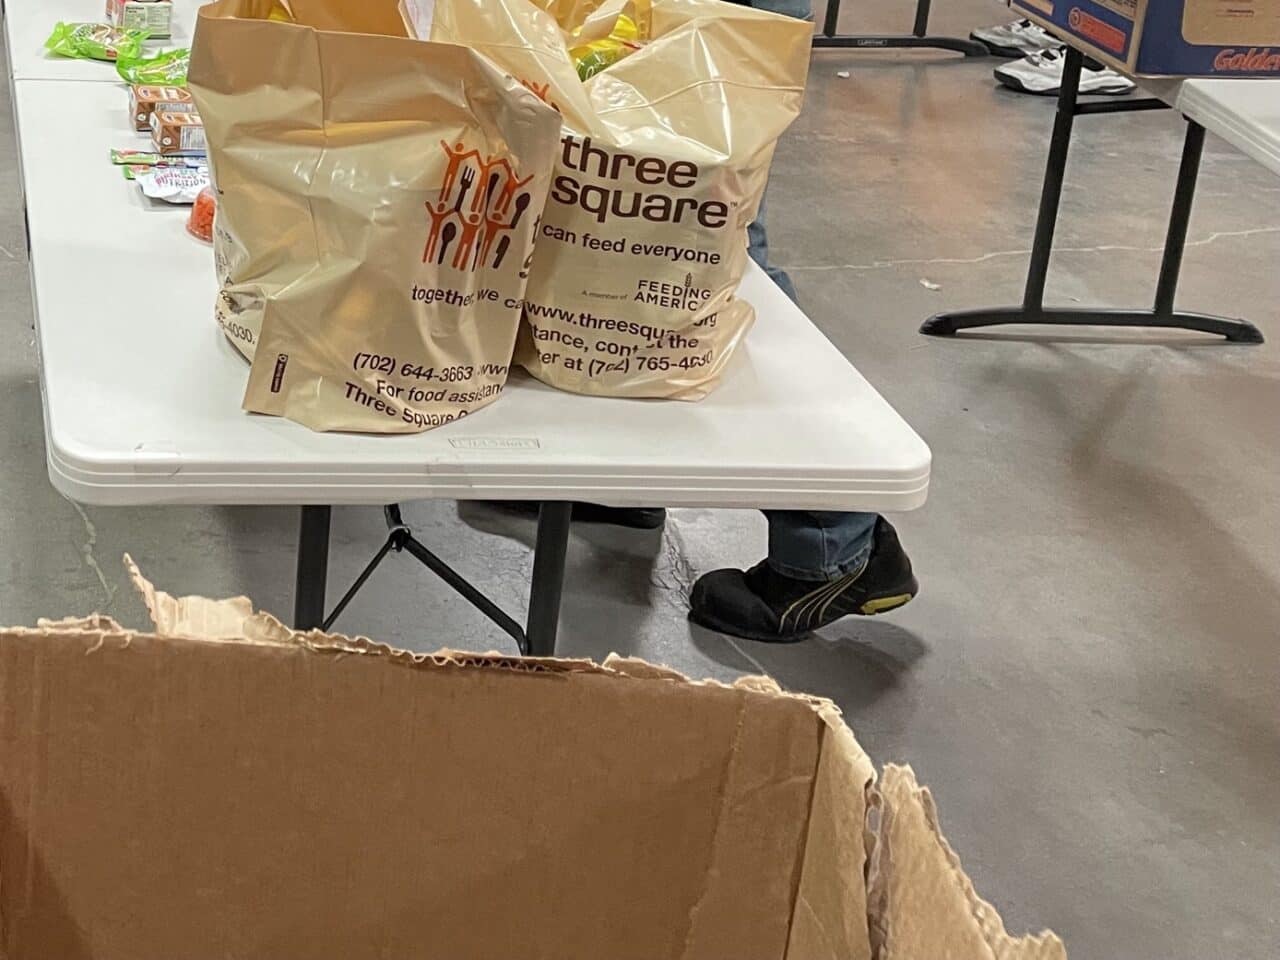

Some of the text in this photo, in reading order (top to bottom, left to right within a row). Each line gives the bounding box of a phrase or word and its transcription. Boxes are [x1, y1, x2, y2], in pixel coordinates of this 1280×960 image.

[561, 134, 699, 189] three
[551, 175, 729, 229] square
[543, 224, 721, 265] can feed everyone
[476, 289, 500, 301] we
[634, 291, 698, 312] AMERIC
[638, 279, 712, 301] FEEDING
[669, 334, 699, 349] the
[353, 351, 397, 376] (702)
[400, 362, 474, 382] 644-3663
[564, 357, 584, 371] at
[376, 379, 407, 398] For
[407, 387, 448, 403] food
[345, 381, 398, 417] Three
[402, 407, 455, 428] Square
